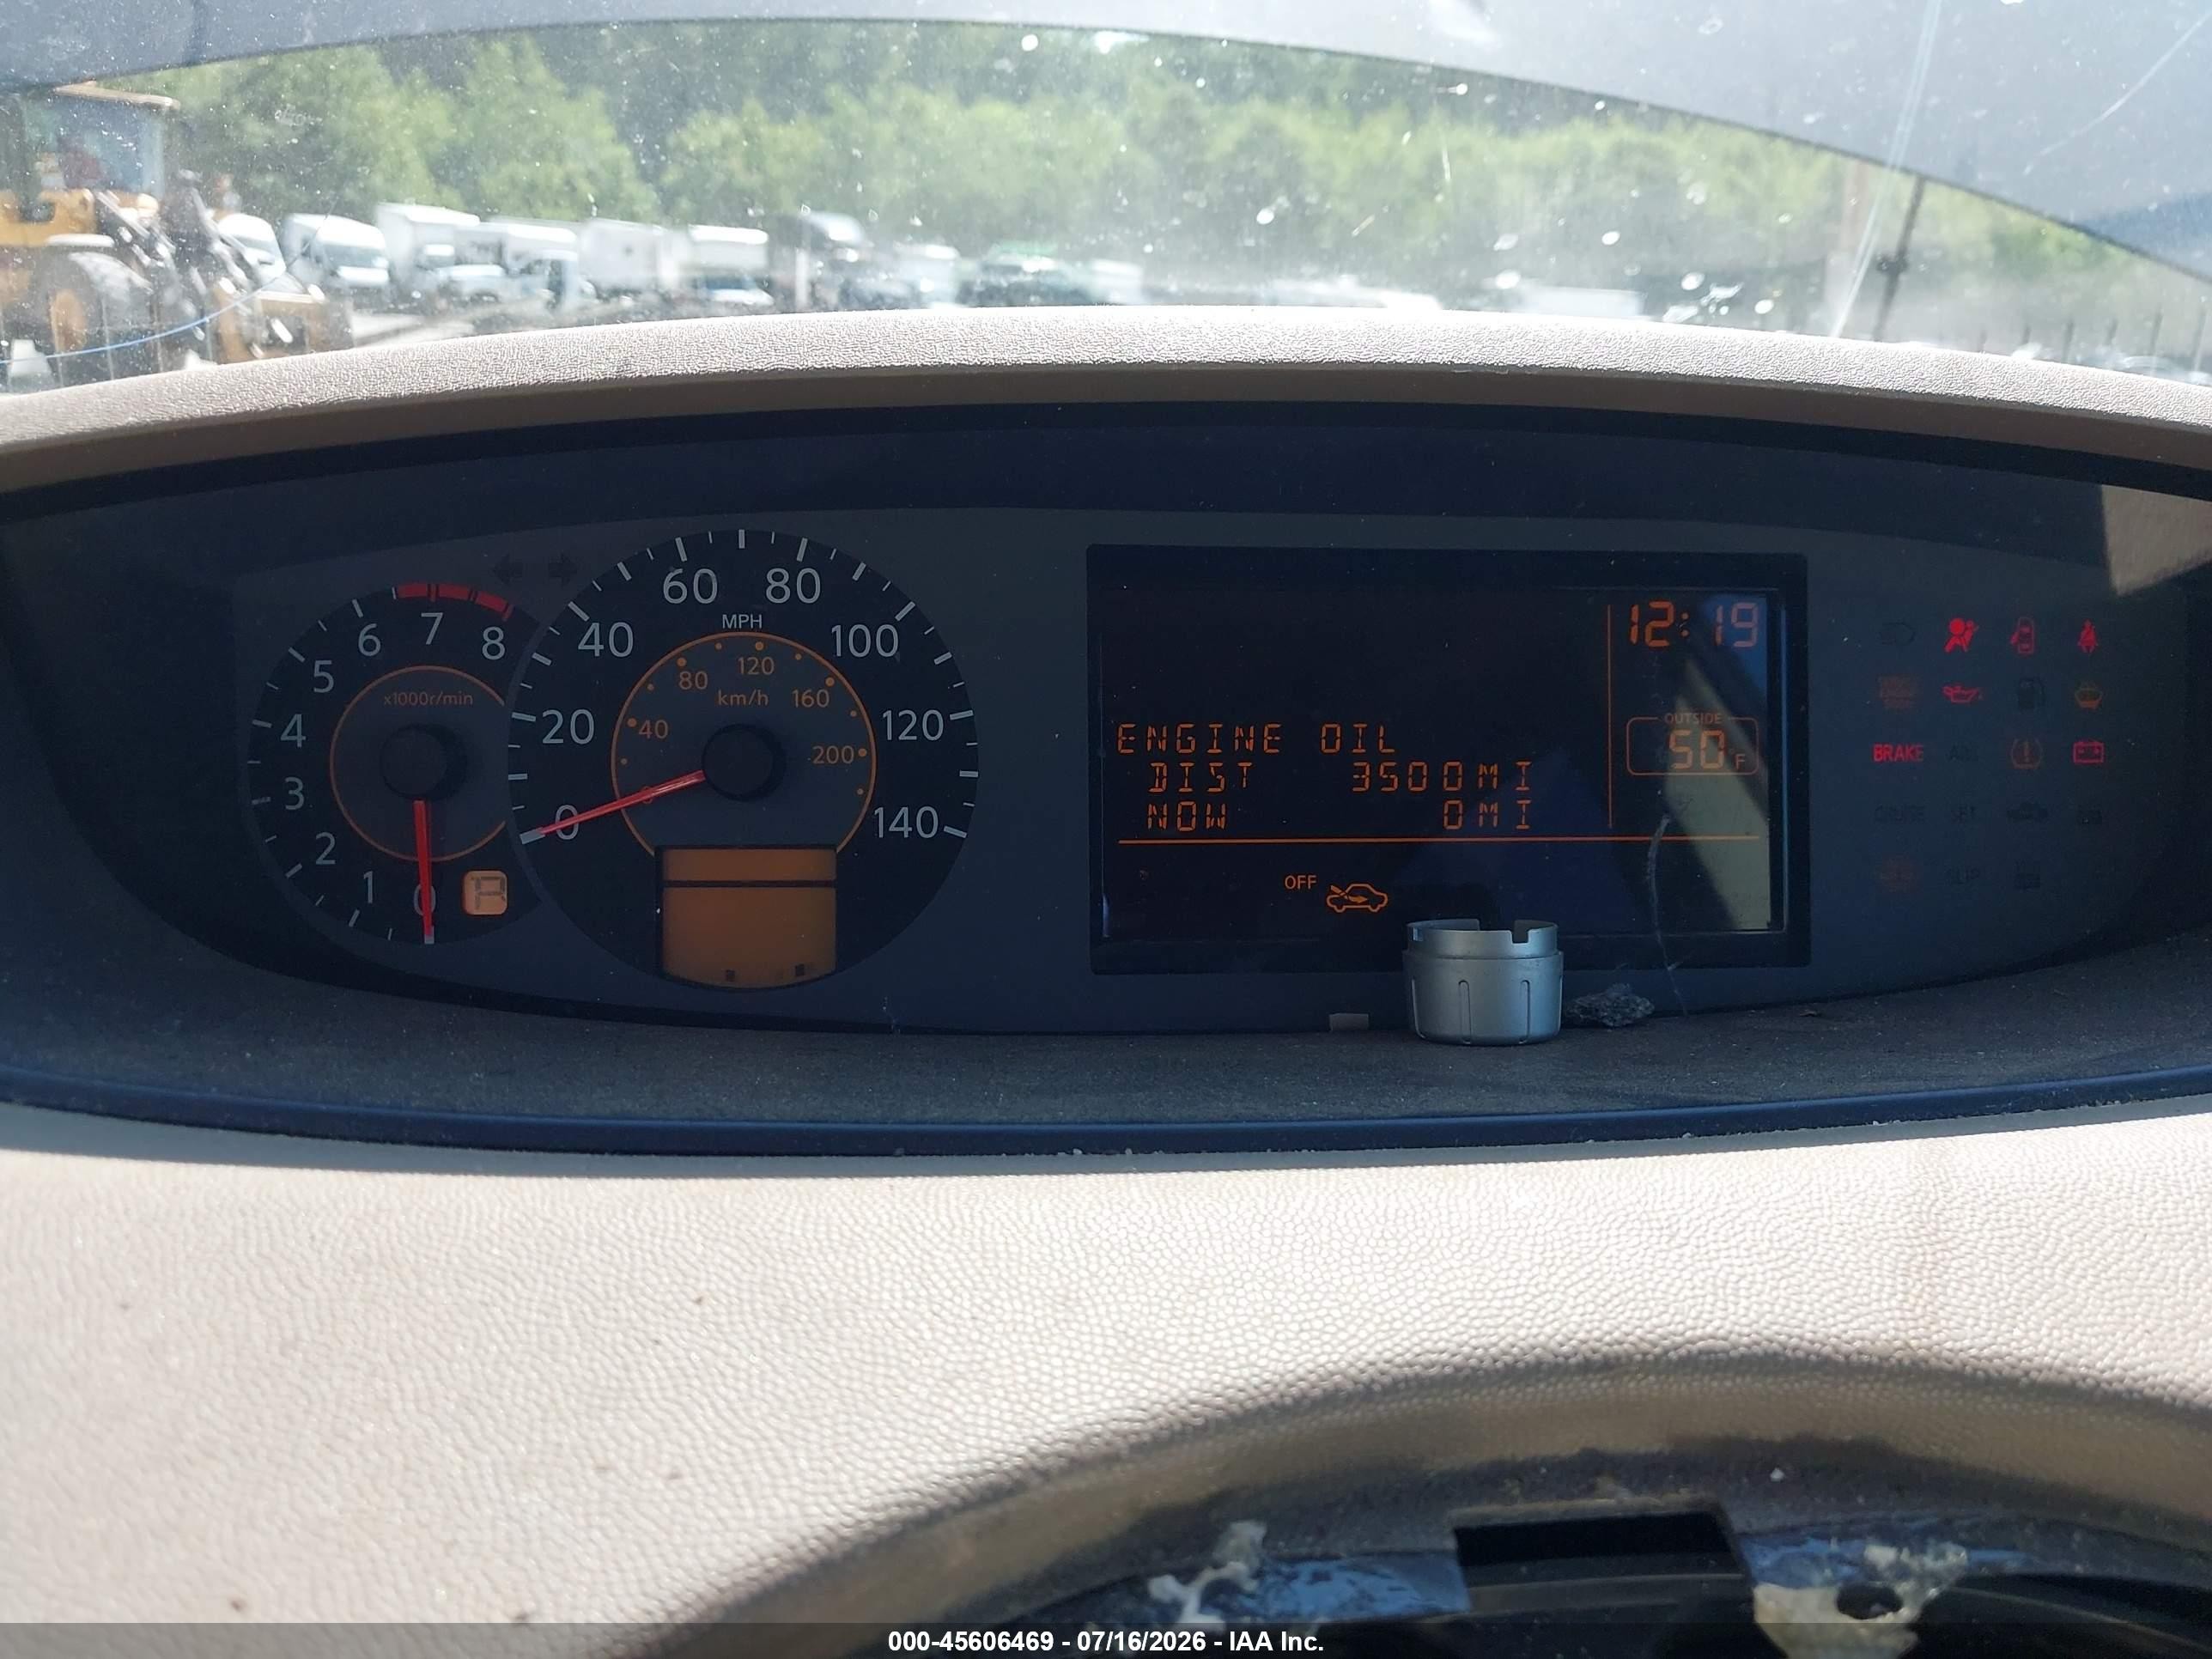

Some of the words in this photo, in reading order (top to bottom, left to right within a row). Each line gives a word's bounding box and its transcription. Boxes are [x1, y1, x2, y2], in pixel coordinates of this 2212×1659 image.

[663, 568, 718, 604] 60
[765, 568, 822, 604] 80
[421, 612, 443, 645] 7
[722, 614, 763, 629] MPH
[1629, 600, 1759, 647] 12:19
[357, 623, 381, 656] 6
[482, 627, 506, 660] 8
[577, 622, 634, 657] 40
[831, 624, 900, 657] 100
[313, 660, 335, 693] 5
[678, 671, 708, 690] 80
[738, 657, 775, 676] 120
[384, 691, 473, 707] x1000r/min
[717, 689, 769, 707] km/h
[792, 690, 830, 708] 160
[281, 714, 307, 748] 4
[542, 709, 595, 744] 20
[639, 720, 669, 738] 40
[883, 709, 945, 741] 120
[1664, 712, 1722, 725] OUTSIDE
[812, 745, 854, 764] 200
[1118, 723, 1282, 754] ENGINE
[1320, 723, 1395, 754] OIL
[1668, 730, 1725, 769] 50
[1873, 743, 1924, 763] BRAKE
[1147, 762, 1253, 793] DIST
[284, 777, 305, 811] 3
[555, 805, 580, 841] 0
[874, 805, 939, 839] 140
[1147, 800, 1226, 832] NOW
[315, 832, 337, 866] 2
[362, 872, 374, 903] 1
[1284, 874, 1317, 890] OFF
[413, 884, 436, 916] 0
